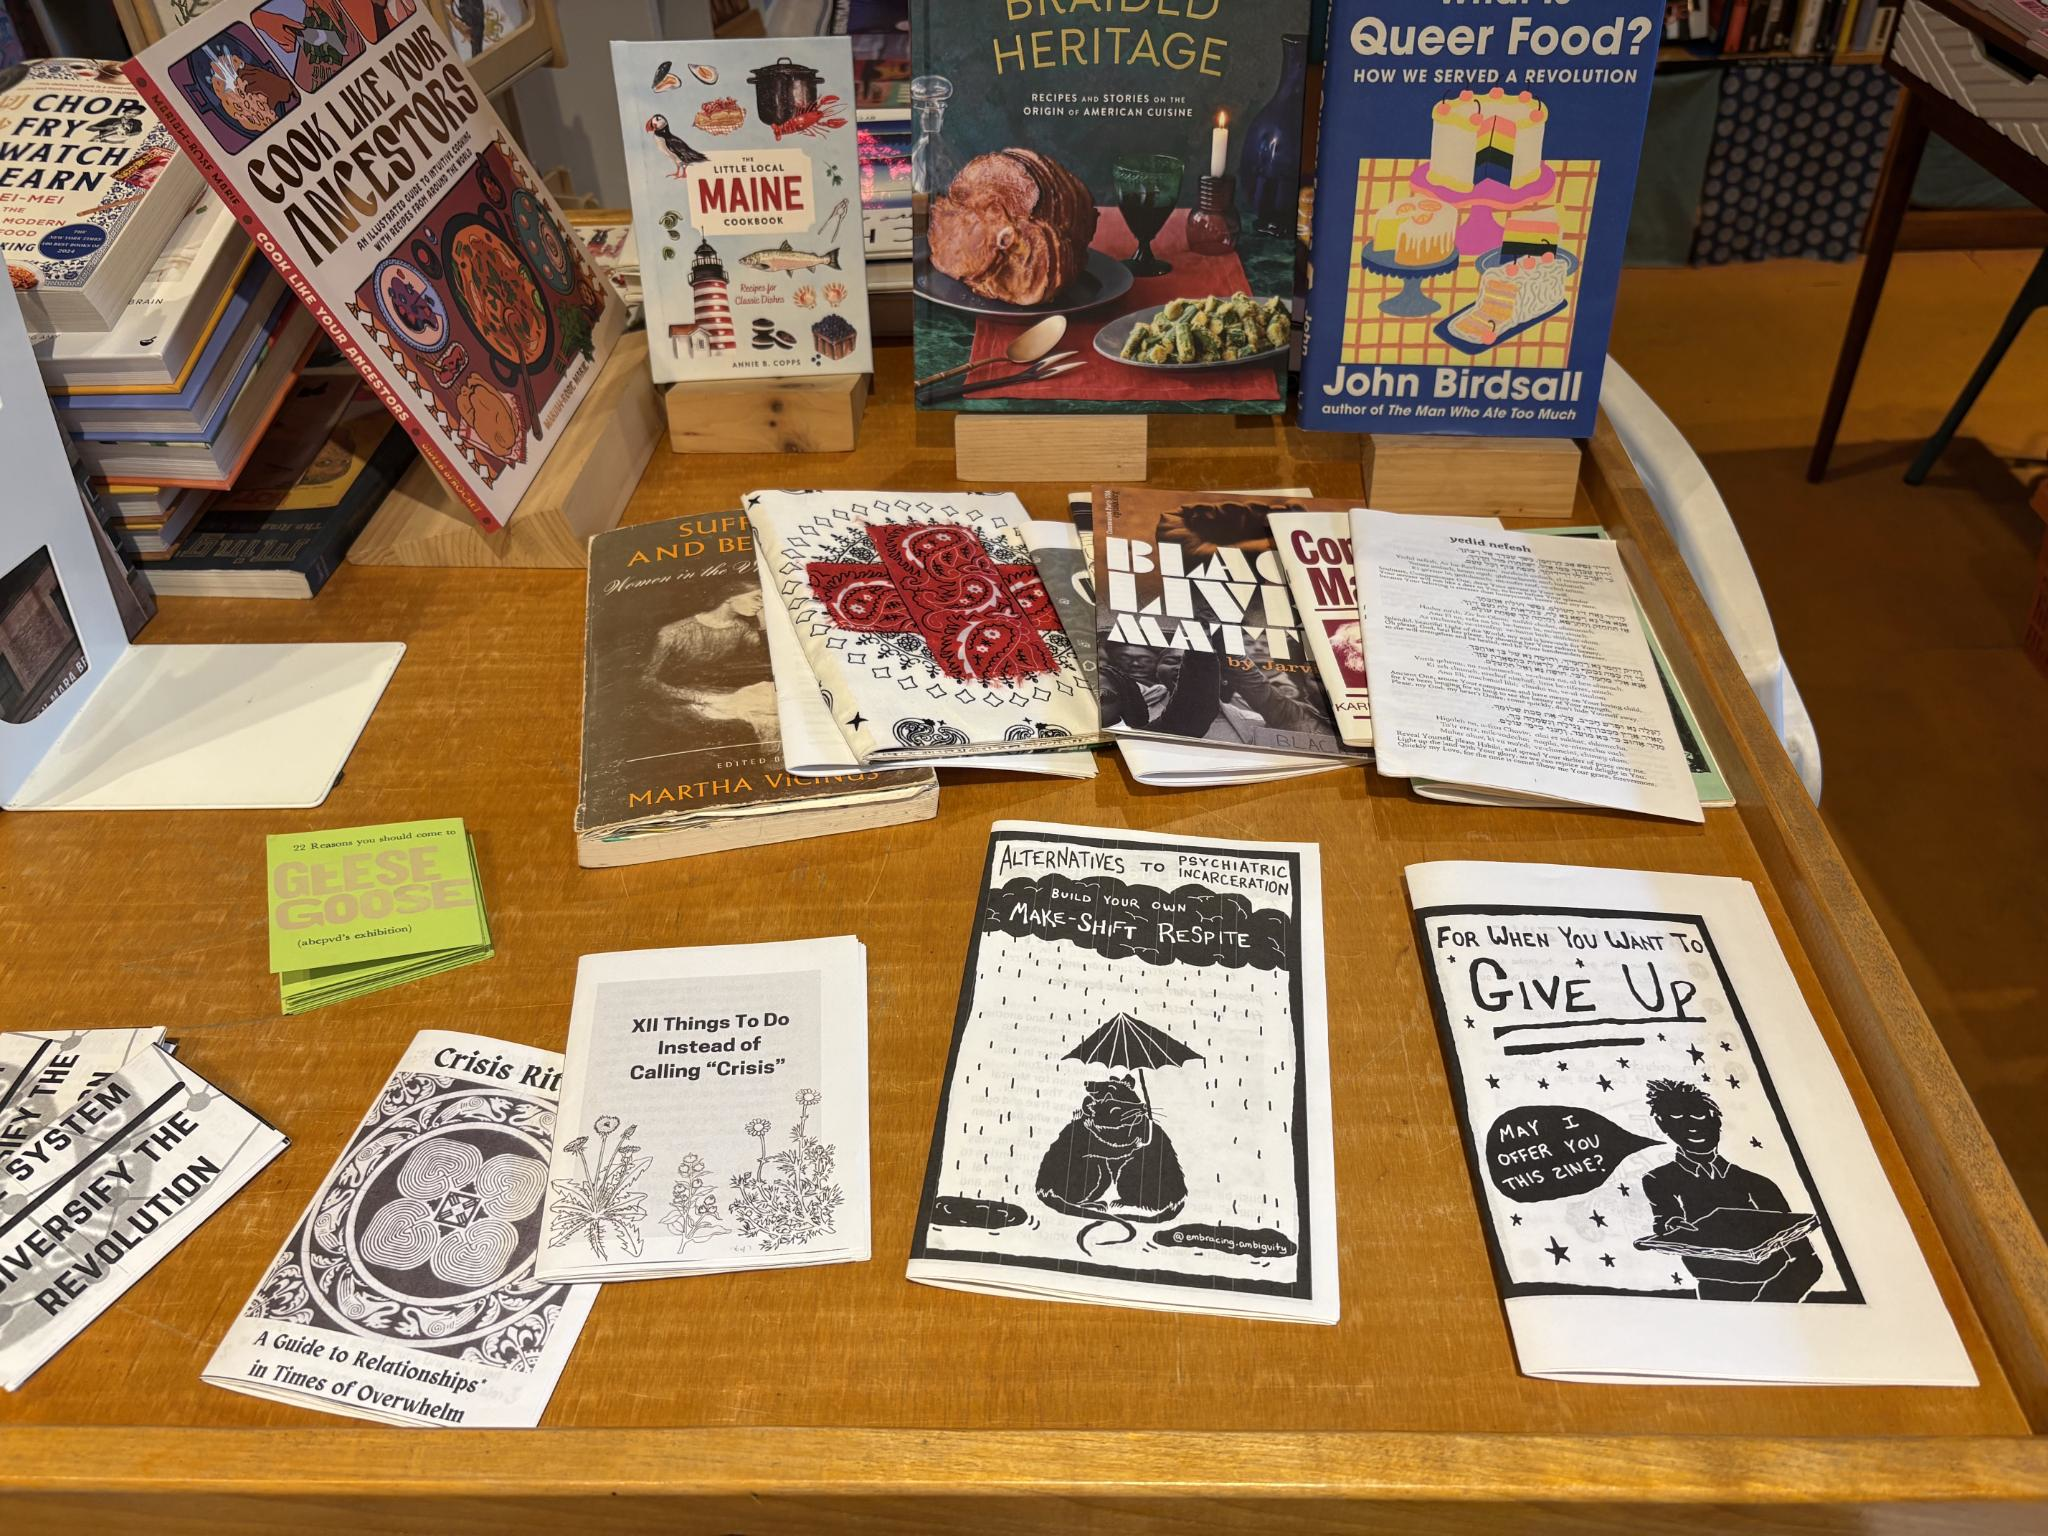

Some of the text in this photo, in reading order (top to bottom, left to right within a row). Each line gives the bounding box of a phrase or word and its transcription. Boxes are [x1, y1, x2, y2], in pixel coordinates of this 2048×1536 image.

[1350, 16, 1652, 56] Queer Food?
[993, 28, 1228, 76] HERITAGE
[1354, 69, 1638, 83] HOW WE SERVED A REVOLUTION
[33, 94, 140, 116] CHOP
[1024, 107, 1064, 116] ORIGIN
[1084, 108, 1142, 116] AMERICAN
[1148, 108, 1192, 116] CUISINE
[1032, 94, 1078, 102] RECIPES
[1104, 94, 1149, 102] STORIES
[248, 24, 448, 203] COOK LIKE YOUR
[11, 118, 89, 138] FRY
[0, 142, 130, 166] WATCH
[284, 64, 478, 268] ANCESTORS
[0, 168, 106, 191] EARN
[714, 164, 784, 174] LITTLE LOCAL
[0, 193, 64, 204] EI-MEI
[212, 173, 240, 204] MARIE
[356, 131, 472, 251] AN ILLUSTRATED GUIDE TO INTUITIVE COOKING
[374, 148, 472, 252] WITH RECIPES FROM AROUND THE WORLD
[698, 176, 804, 214] MAINE
[2, 218, 67, 226] MODERN
[724, 217, 784, 226] COOKBOOK
[0, 242, 36, 252] KING
[735, 296, 784, 305] Classic Dishes
[740, 284, 766, 293] Recipes
[256, 232, 410, 422] COOK LIKE YOUR ANCESTORS
[1323, 366, 1582, 401] John Birdsall
[1322, 404, 1576, 420] author of The Man Who Ate Too Much
[680, 516, 751, 538] SUFF
[627, 536, 752, 567] AND BE
[1450, 536, 1532, 553] yedid nefesh
[1106, 536, 1286, 584] BLAC
[604, 575, 671, 596] Women
[677, 570, 695, 580] in
[700, 561, 727, 577] the
[1107, 614, 1313, 661] MATT
[1228, 656, 1312, 674] by Jarv
[1335, 703, 1370, 712] KAR
[717, 758, 766, 769] EDITED
[629, 777, 752, 808] MARTHA
[293, 844, 306, 852] 22
[310, 840, 353, 851] Reasons
[356, 838, 376, 848] you
[379, 832, 412, 843] should
[416, 831, 442, 839] come
[272, 846, 442, 898] GEESE
[1000, 844, 1288, 878] ALTERNATIVES TO PSYCHIATRIC
[1178, 868, 1289, 896] INCARCERATION
[274, 879, 476, 930] GOOSE
[1052, 888, 1186, 912] BUILD YOUR OWN
[354, 924, 413, 940] exhibition)
[1009, 902, 1251, 948] MAKE-SHIFT RESPITE
[1437, 926, 1704, 954] FOR WHEN YOU WANT TO
[1469, 957, 1697, 1018] GIVE UP
[632, 1012, 790, 1032] XII Things To Do
[658, 1036, 761, 1054] Instead of
[28, 1054, 80, 1098] THE
[434, 1048, 563, 1092] Crisis Rit
[630, 1058, 785, 1080] Calling “Crisis”
[5, 1082, 131, 1181] SYSTEM
[132, 1111, 199, 1162] THE
[1499, 1116, 1580, 1142] MAY I
[1497, 1134, 1600, 1166] OFFER YOU
[1502, 1154, 1607, 1191] THIS ZINE?
[34, 1156, 222, 1317] REVOLUTION
[1173, 1232, 1287, 1254] @embracing.ambiguity
[253, 1330, 269, 1346] A
[273, 1333, 325, 1358] Guide
[329, 1346, 348, 1363] to
[248, 1360, 464, 1424] in Times of Overwhelm
